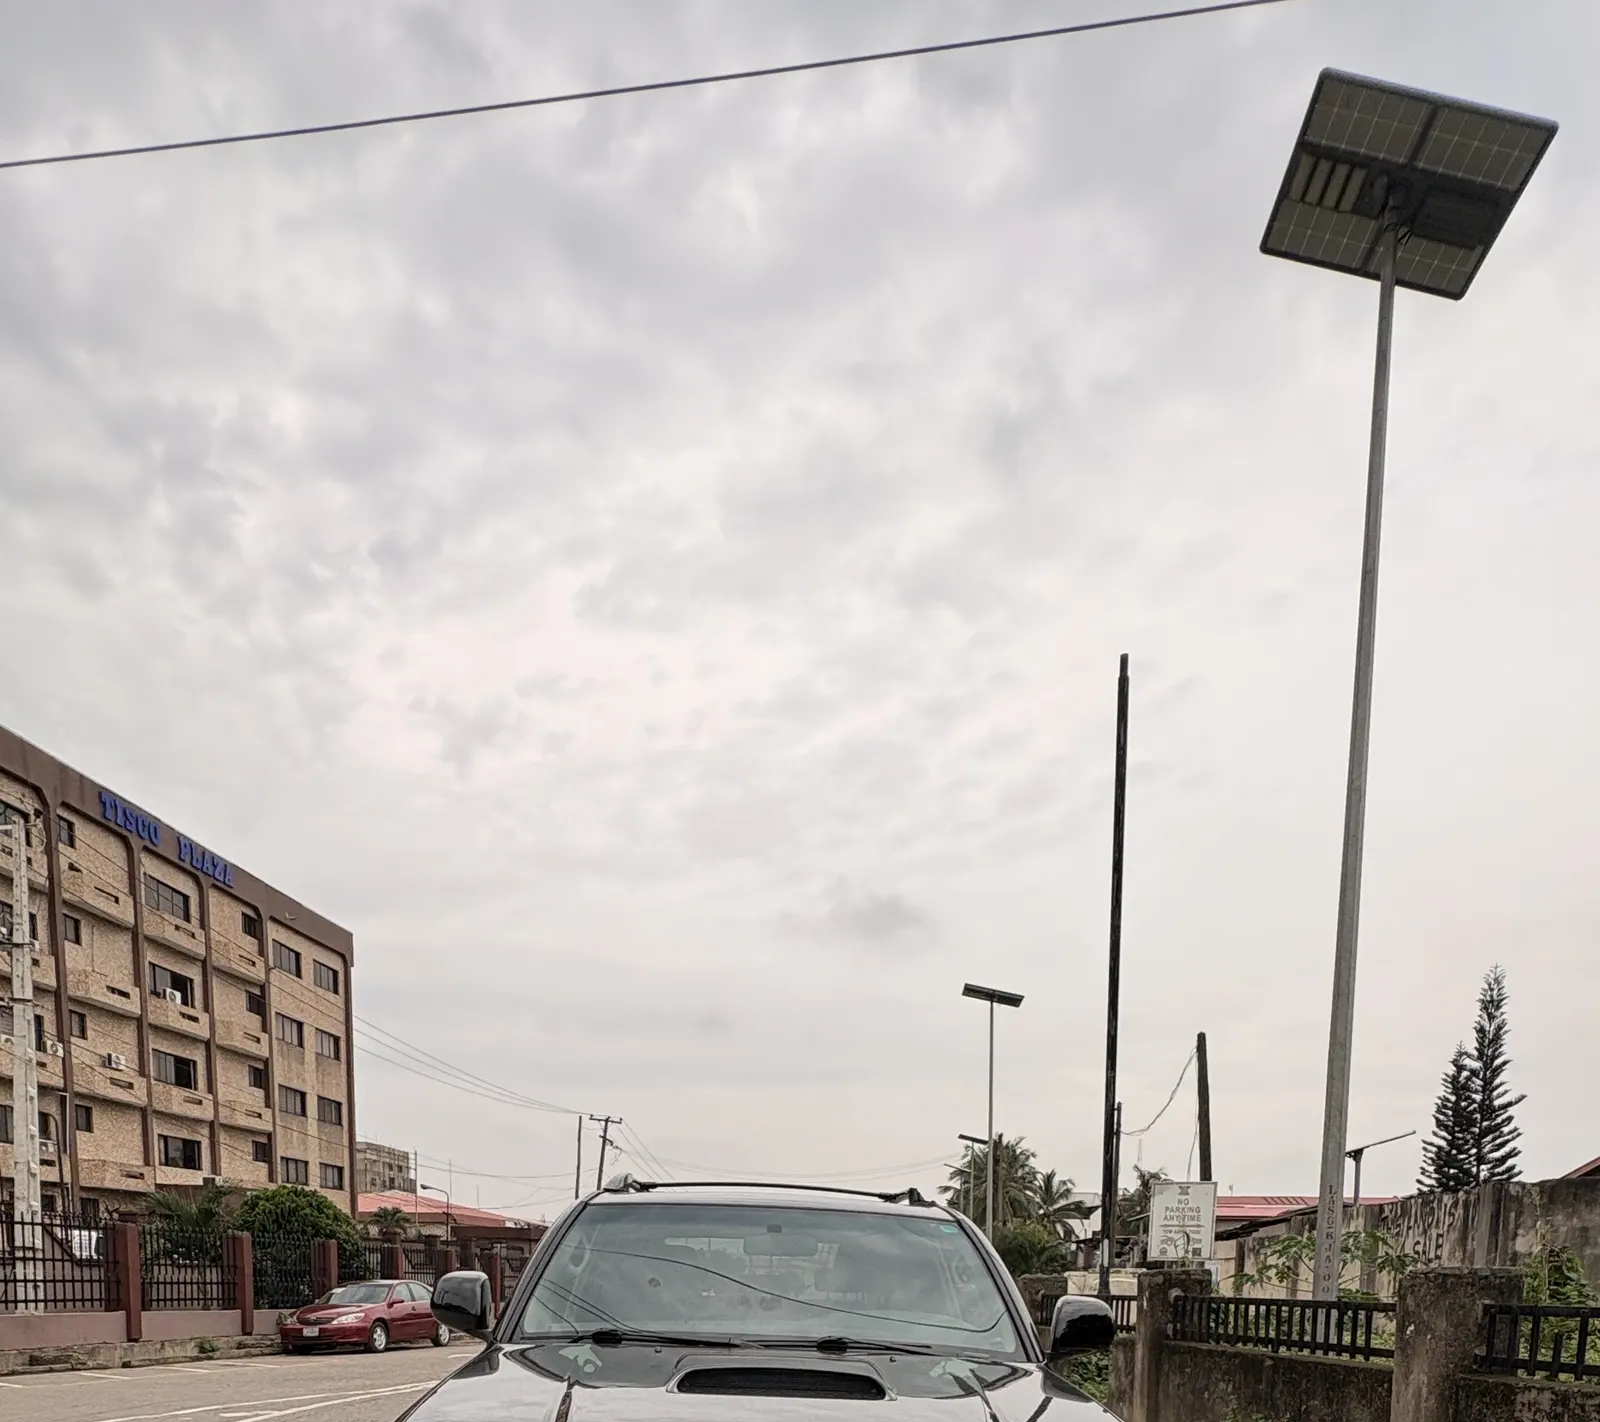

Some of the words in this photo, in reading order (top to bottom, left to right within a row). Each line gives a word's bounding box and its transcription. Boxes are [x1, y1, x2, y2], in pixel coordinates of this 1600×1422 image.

[98, 791, 160, 847] TISCO
[177, 836, 234, 888] PLAZA
[1165, 1206, 1201, 1214] PARKING
[1412, 1231, 1443, 1263] SALE
